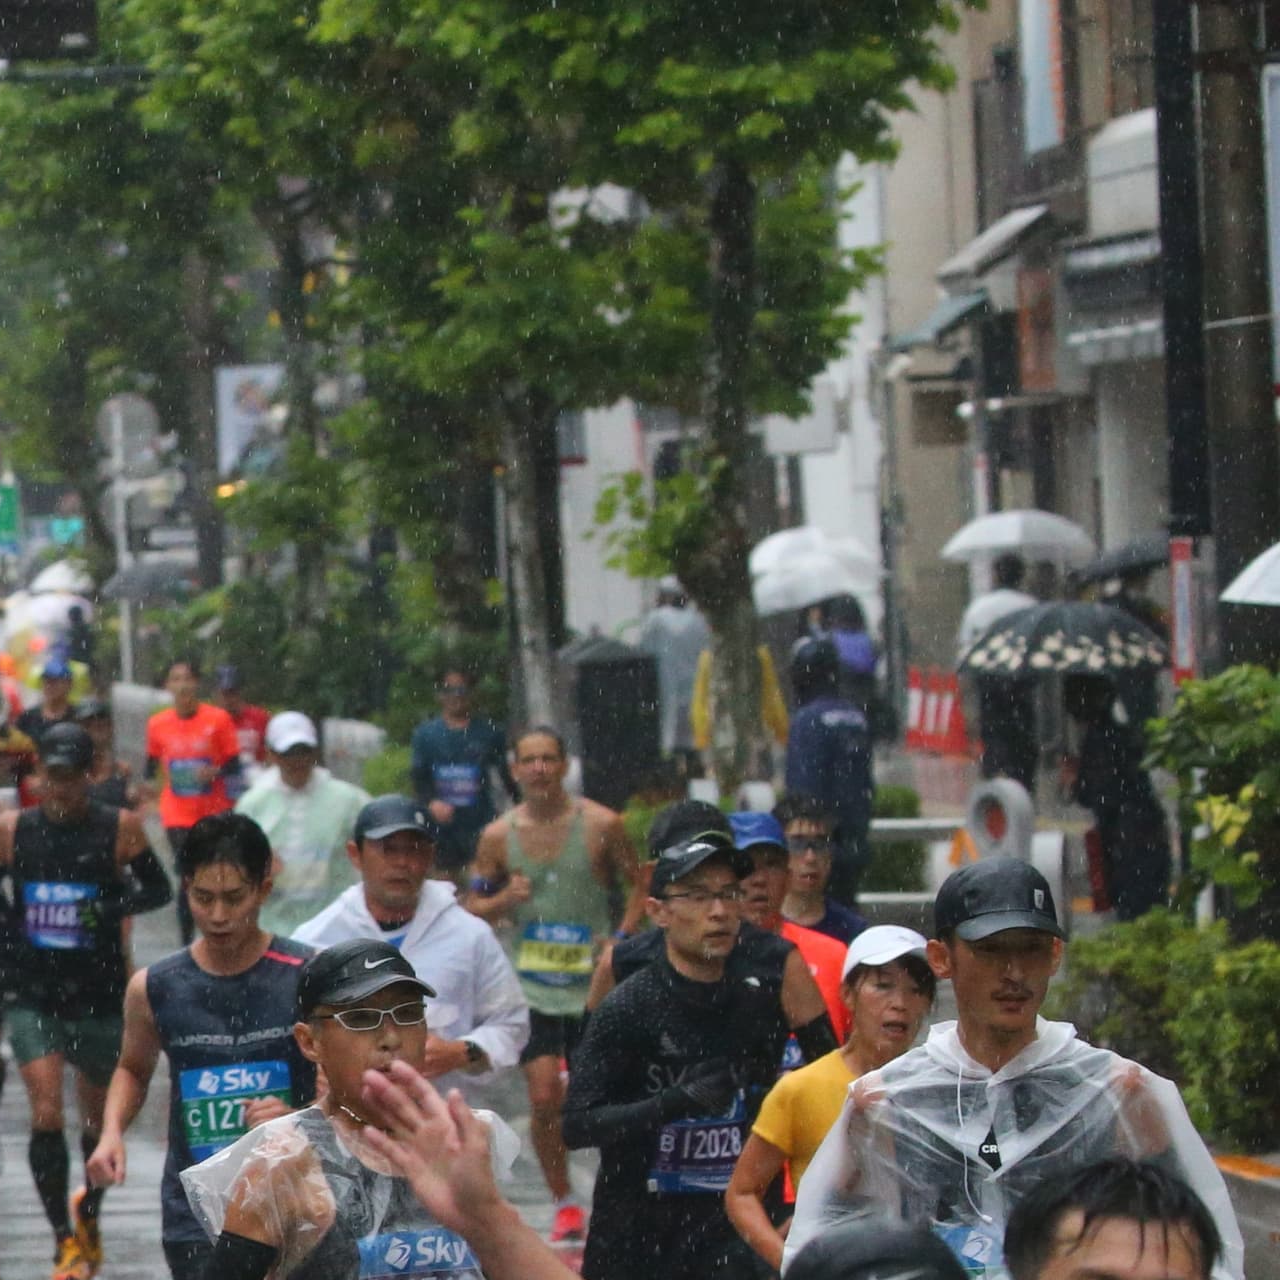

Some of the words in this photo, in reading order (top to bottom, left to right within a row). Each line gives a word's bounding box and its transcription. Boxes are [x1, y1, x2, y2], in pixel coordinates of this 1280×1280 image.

[179, 1033, 234, 1047] UNDER
[222, 1068, 271, 1091] Sky
[187, 1108, 202, 1128] C
[414, 1235, 468, 1267] Sky
